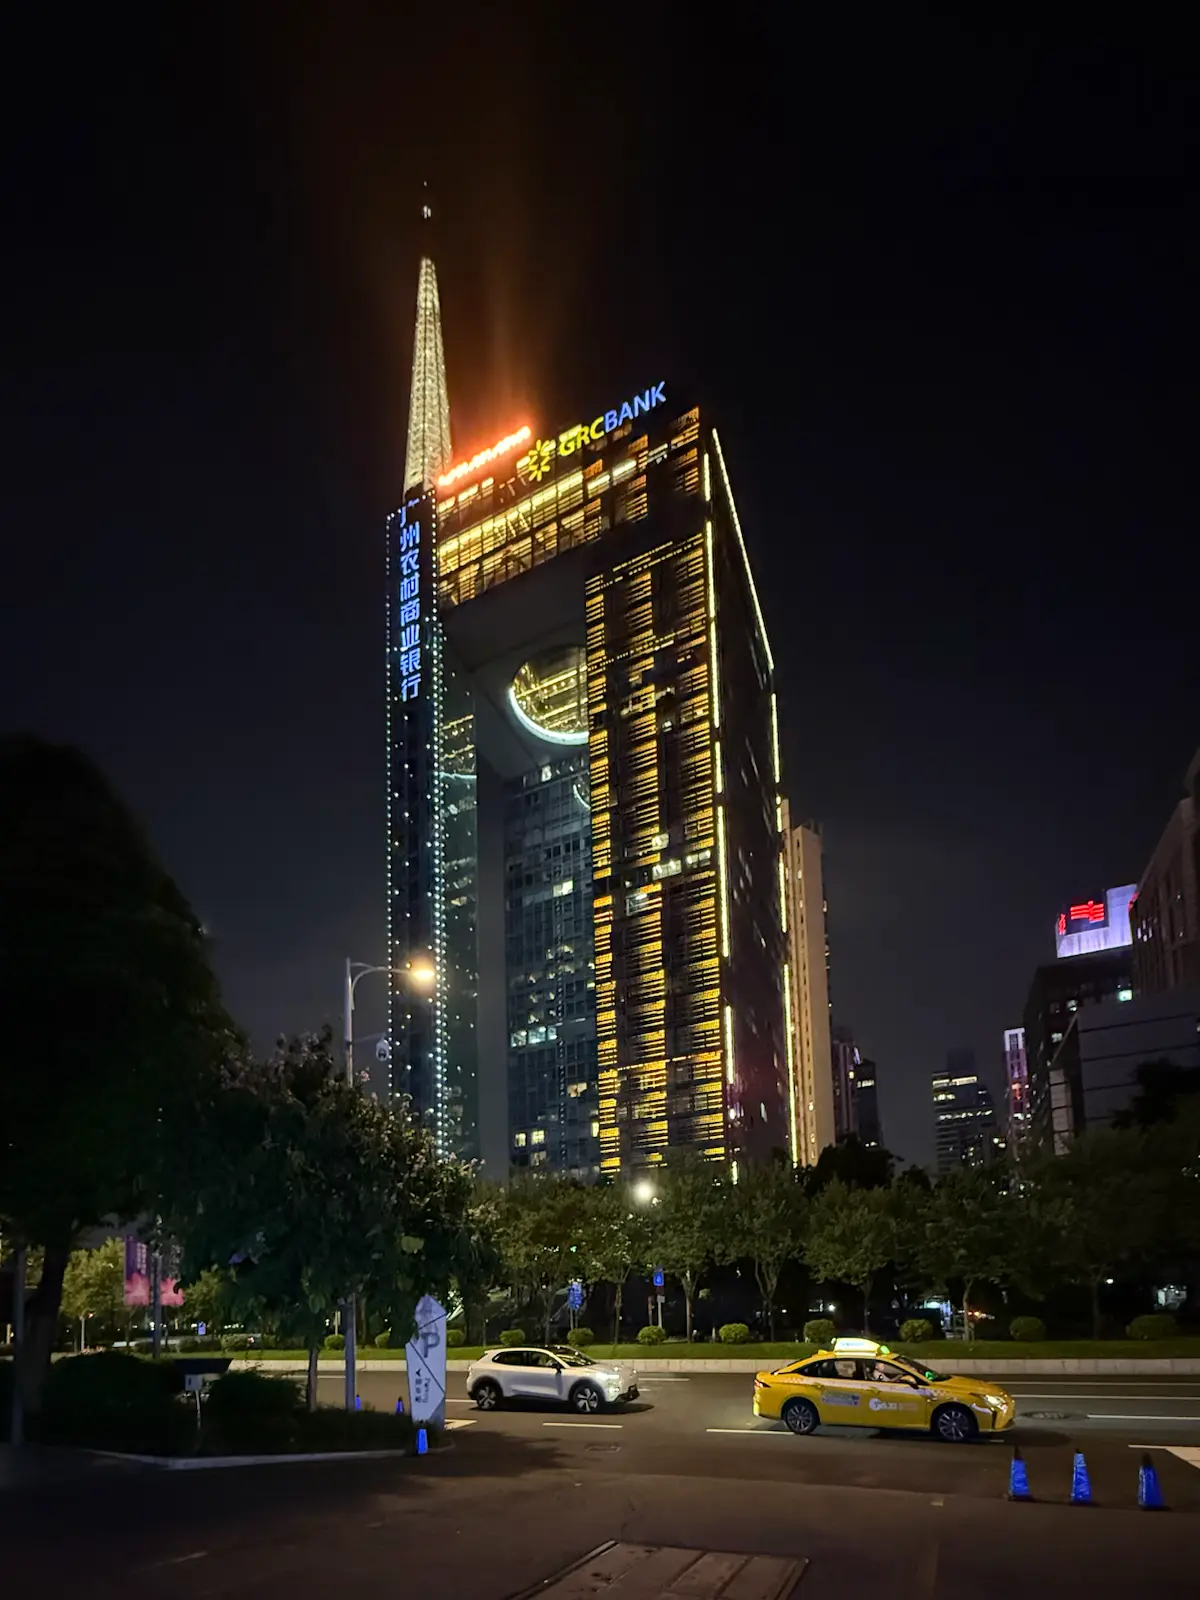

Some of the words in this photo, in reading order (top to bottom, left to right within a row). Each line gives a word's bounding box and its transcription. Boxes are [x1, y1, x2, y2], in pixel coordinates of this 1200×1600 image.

[560, 381, 666, 456] GRCBANK
[400, 498, 421, 702] 广州农村商业银行
[421, 1332, 440, 1358] P
